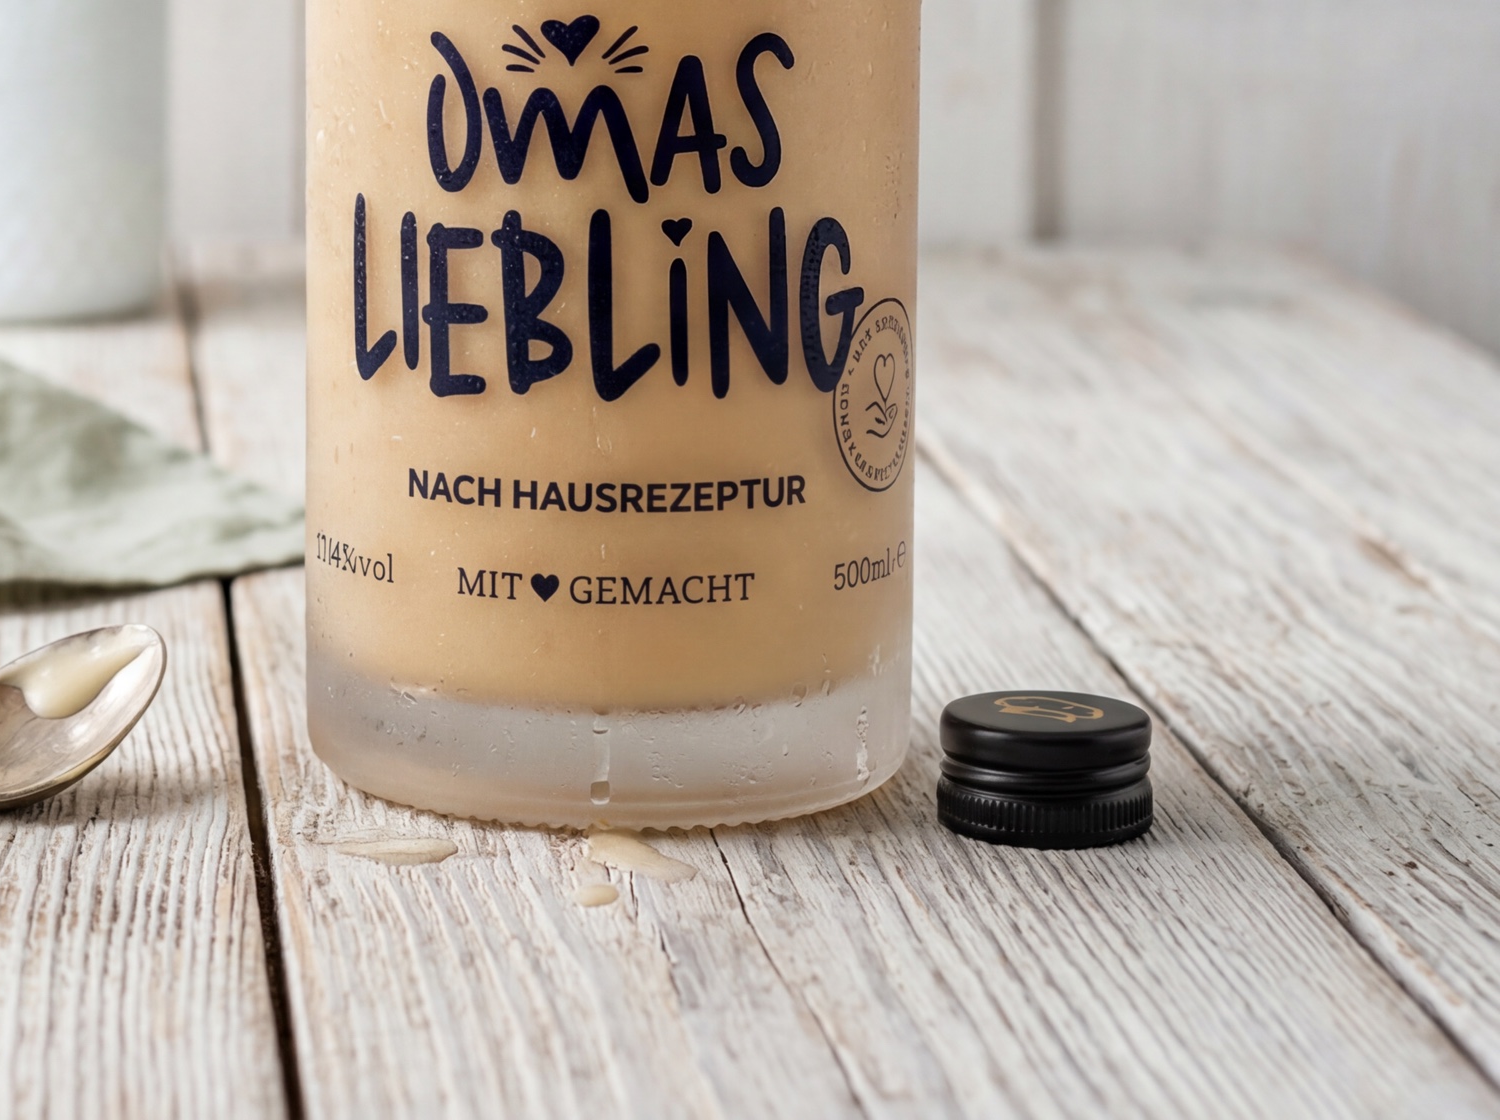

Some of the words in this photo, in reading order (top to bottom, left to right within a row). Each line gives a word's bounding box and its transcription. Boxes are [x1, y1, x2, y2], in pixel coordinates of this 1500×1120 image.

[409, 468, 501, 507] NACH
[513, 475, 806, 513] HAUSREZEPTUR
[457, 567, 522, 600] MIT
[569, 572, 755, 605] GEMACHT
